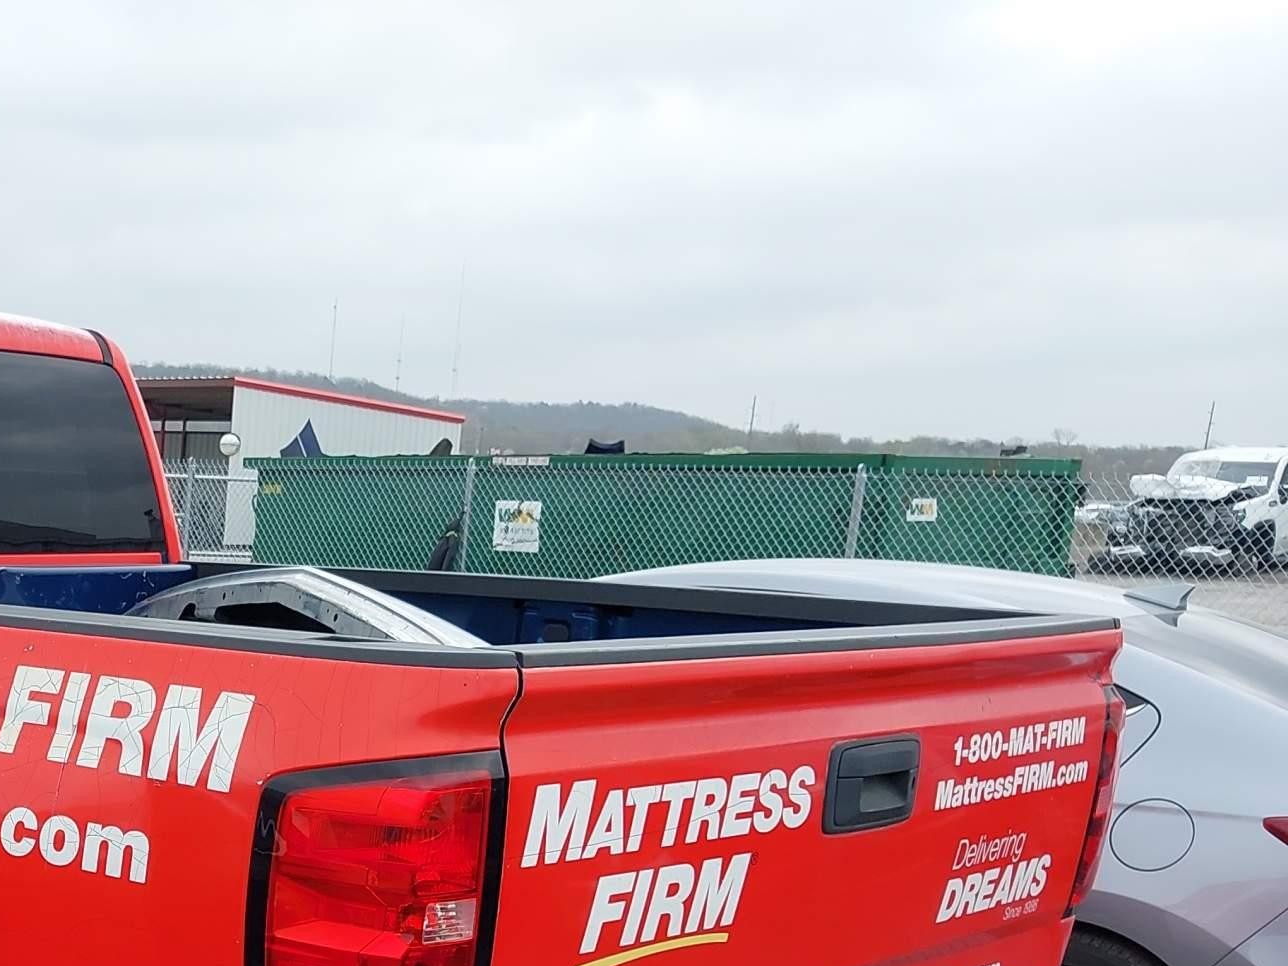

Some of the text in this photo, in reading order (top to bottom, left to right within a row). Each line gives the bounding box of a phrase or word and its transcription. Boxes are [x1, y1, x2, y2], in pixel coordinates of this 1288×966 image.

[954, 716, 1087, 766] 1-800-MAT-FIRM
[934, 760, 1088, 811] MattressFIRM.com
[520, 765, 816, 869] MATTRESS
[952, 829, 1027, 871] Delivering
[579, 852, 753, 955] FIRM
[935, 854, 1051, 924] DREAMS
[1002, 904, 1021, 921] Since
